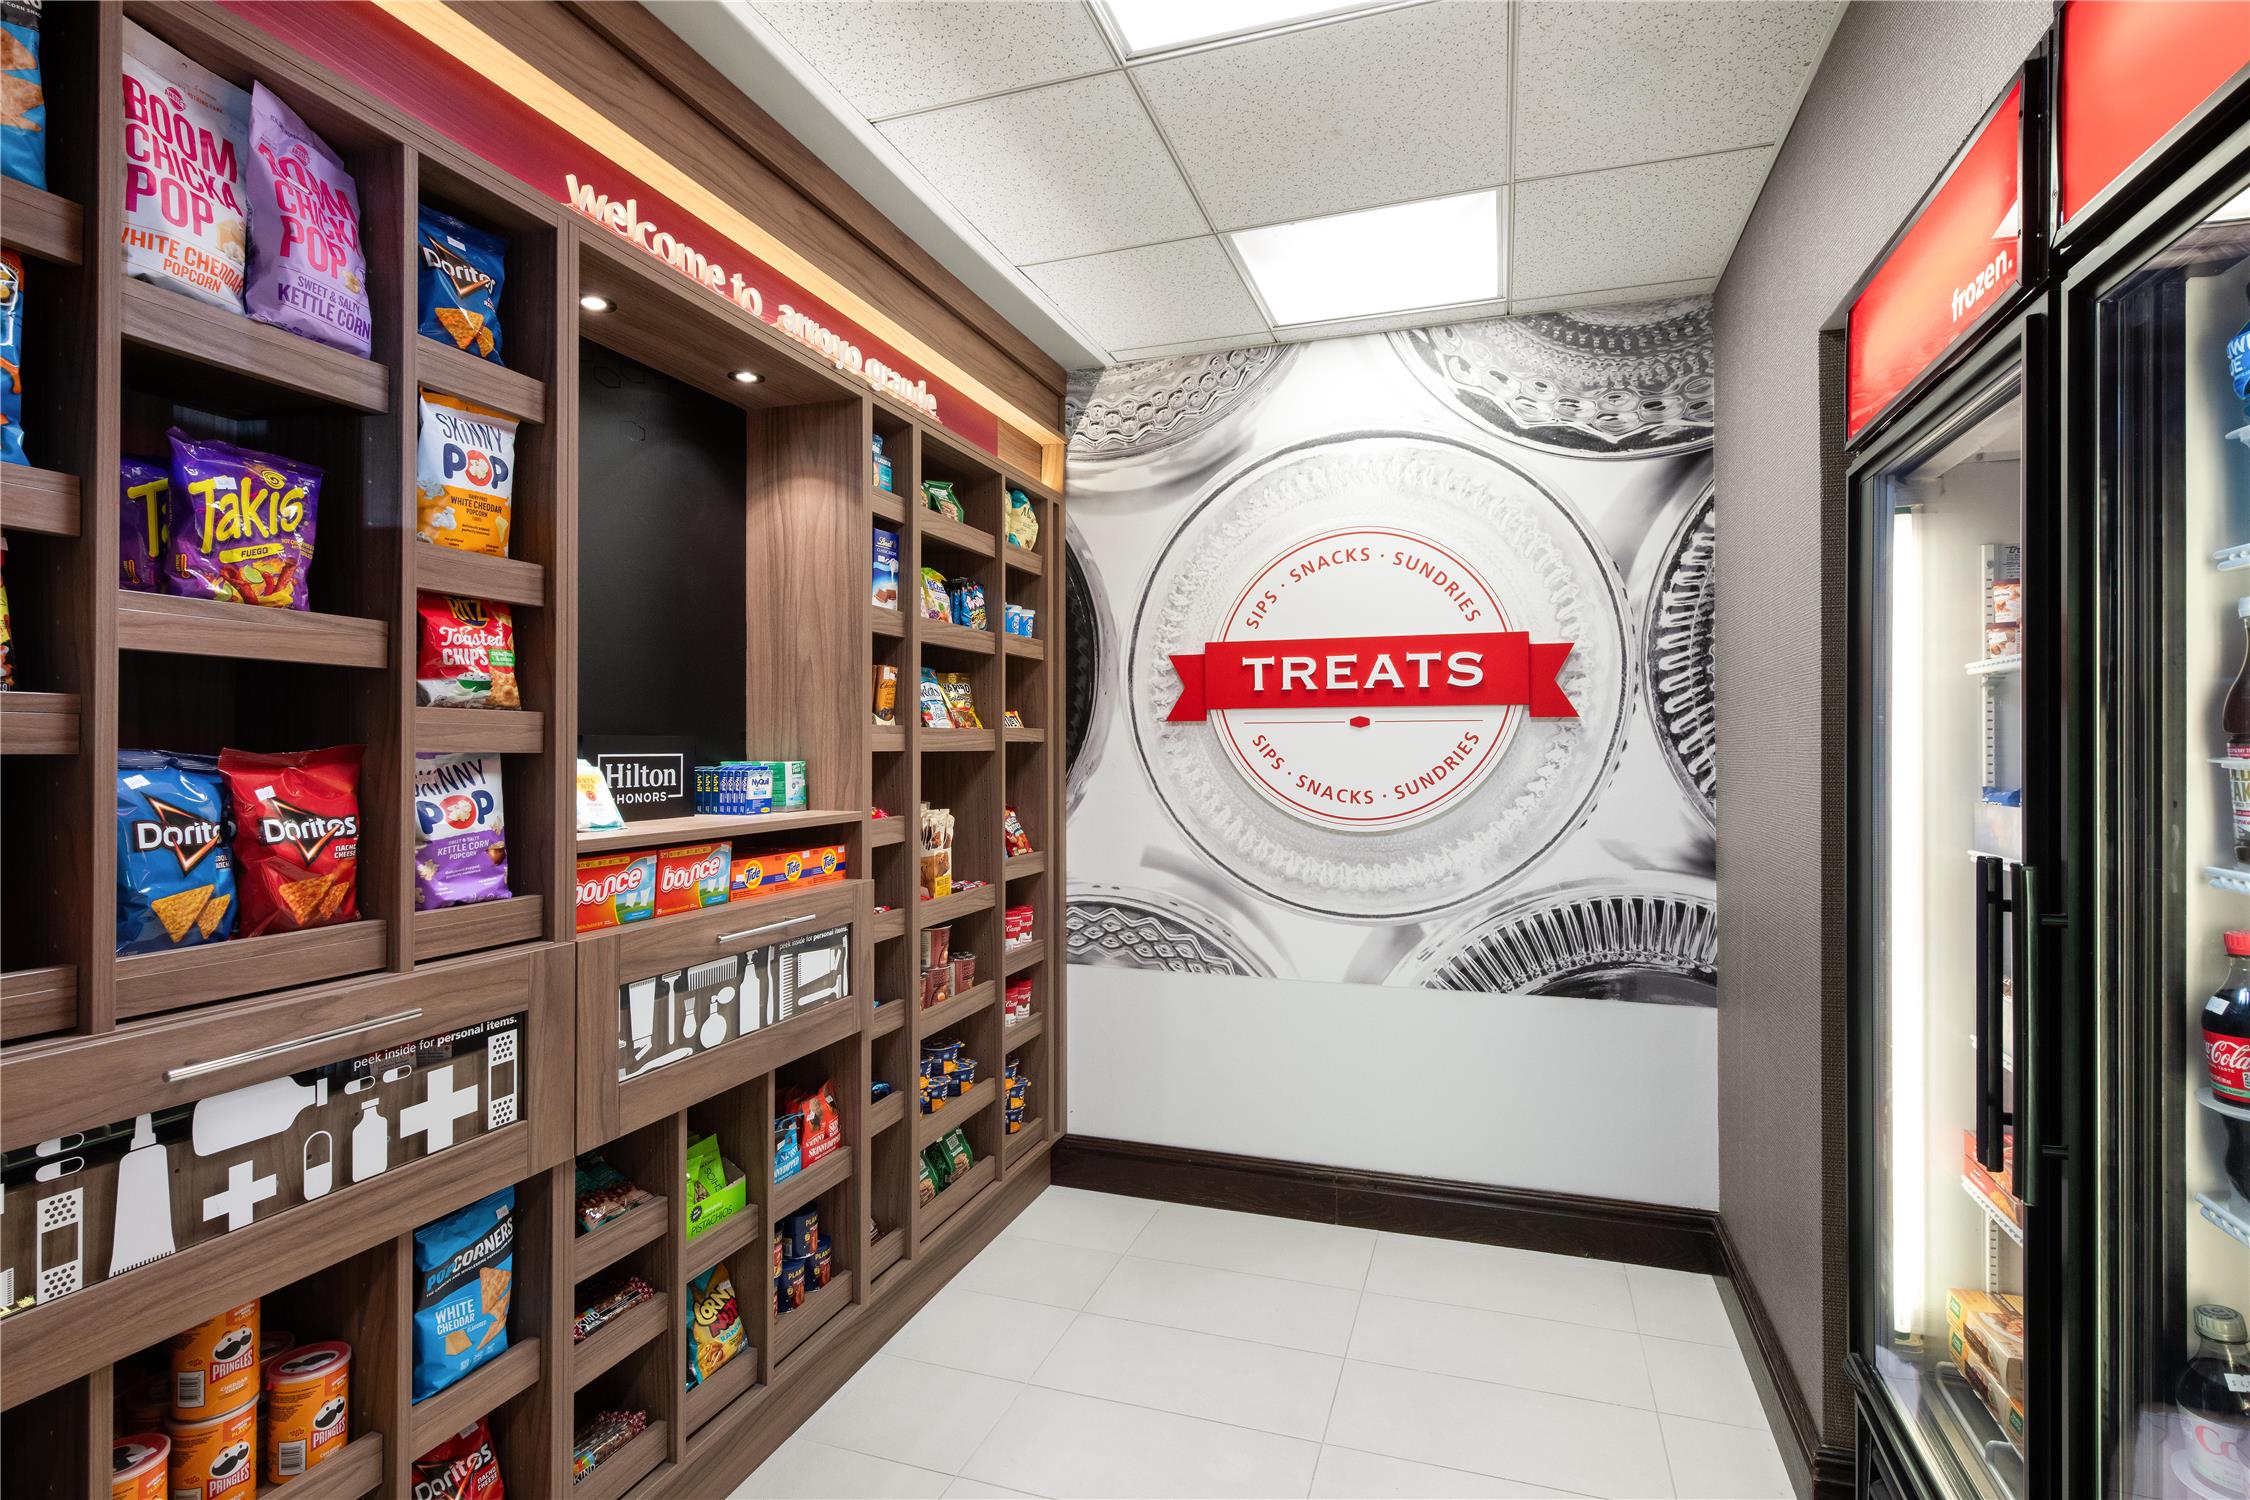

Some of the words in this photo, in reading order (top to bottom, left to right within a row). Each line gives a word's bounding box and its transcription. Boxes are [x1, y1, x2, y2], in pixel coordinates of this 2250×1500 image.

[122, 74, 237, 184] BOOM
[125, 123, 243, 217] CHICKA
[125, 164, 214, 237] POP
[280, 215, 347, 280] POP
[163, 258, 222, 293] POPCORN
[184, 246, 244, 296] CHEDDAR
[1951, 249, 2013, 323] frozen.
[278, 283, 333, 322] KETTLE
[337, 309, 371, 340] CORN
[297, 275, 328, 299] SWEET
[329, 292, 337, 303] &
[338, 295, 360, 316] SALTY
[566, 174, 726, 296] welcome
[730, 273, 763, 317] to
[865, 357, 938, 416] grande
[435, 413, 503, 453] SKINNY
[443, 443, 509, 490] POP
[188, 476, 305, 554] Takis
[450, 495, 472, 508] WHITE
[473, 501, 502, 514] CHEDDAR
[466, 508, 488, 517] POPCORN
[241, 547, 269, 557] FUEGO
[1244, 588, 1278, 630] SIPS
[1288, 547, 1371, 583] SNACKS
[1392, 551, 1481, 623] SUNDRIES
[439, 626, 505, 647] Toasted
[442, 647, 489, 666] CHIPS
[1241, 651, 1485, 692] TREATS
[605, 761, 677, 789] Hilton
[1252, 734, 1282, 771] SIPS
[1295, 774, 1374, 805] SNACKS
[1393, 730, 1480, 800] SUNDRIES
[415, 789, 494, 834] POP
[616, 792, 667, 805] HONORS
[263, 816, 357, 843] Doritos
[437, 843, 467, 856] KETTLE
[468, 839, 490, 849] CORN
[449, 851, 477, 860] POPCORN
[823, 855, 836, 870] Tide
[662, 858, 720, 891] bounce
[745, 868, 761, 883] Tide
[786, 861, 801, 877] Tide
[813, 928, 834, 942] personal
[353, 1053, 381, 1071] peek
[385, 1042, 416, 1060] inside
[419, 1038, 435, 1050] for
[437, 1024, 484, 1047] personal
[486, 1015, 517, 1031] items.
[2211, 1041, 2250, 1070] Cola
[691, 1205, 733, 1237] PISTACHIOS
[435, 1299, 475, 1325] WHITE
[437, 1313, 475, 1335] CHEDDAR
[576, 1312, 600, 1328] KIND
[212, 1348, 253, 1381] PRINGLES
[312, 1416, 346, 1449] PRINGLES
[209, 1462, 250, 1498] PRINGLES
